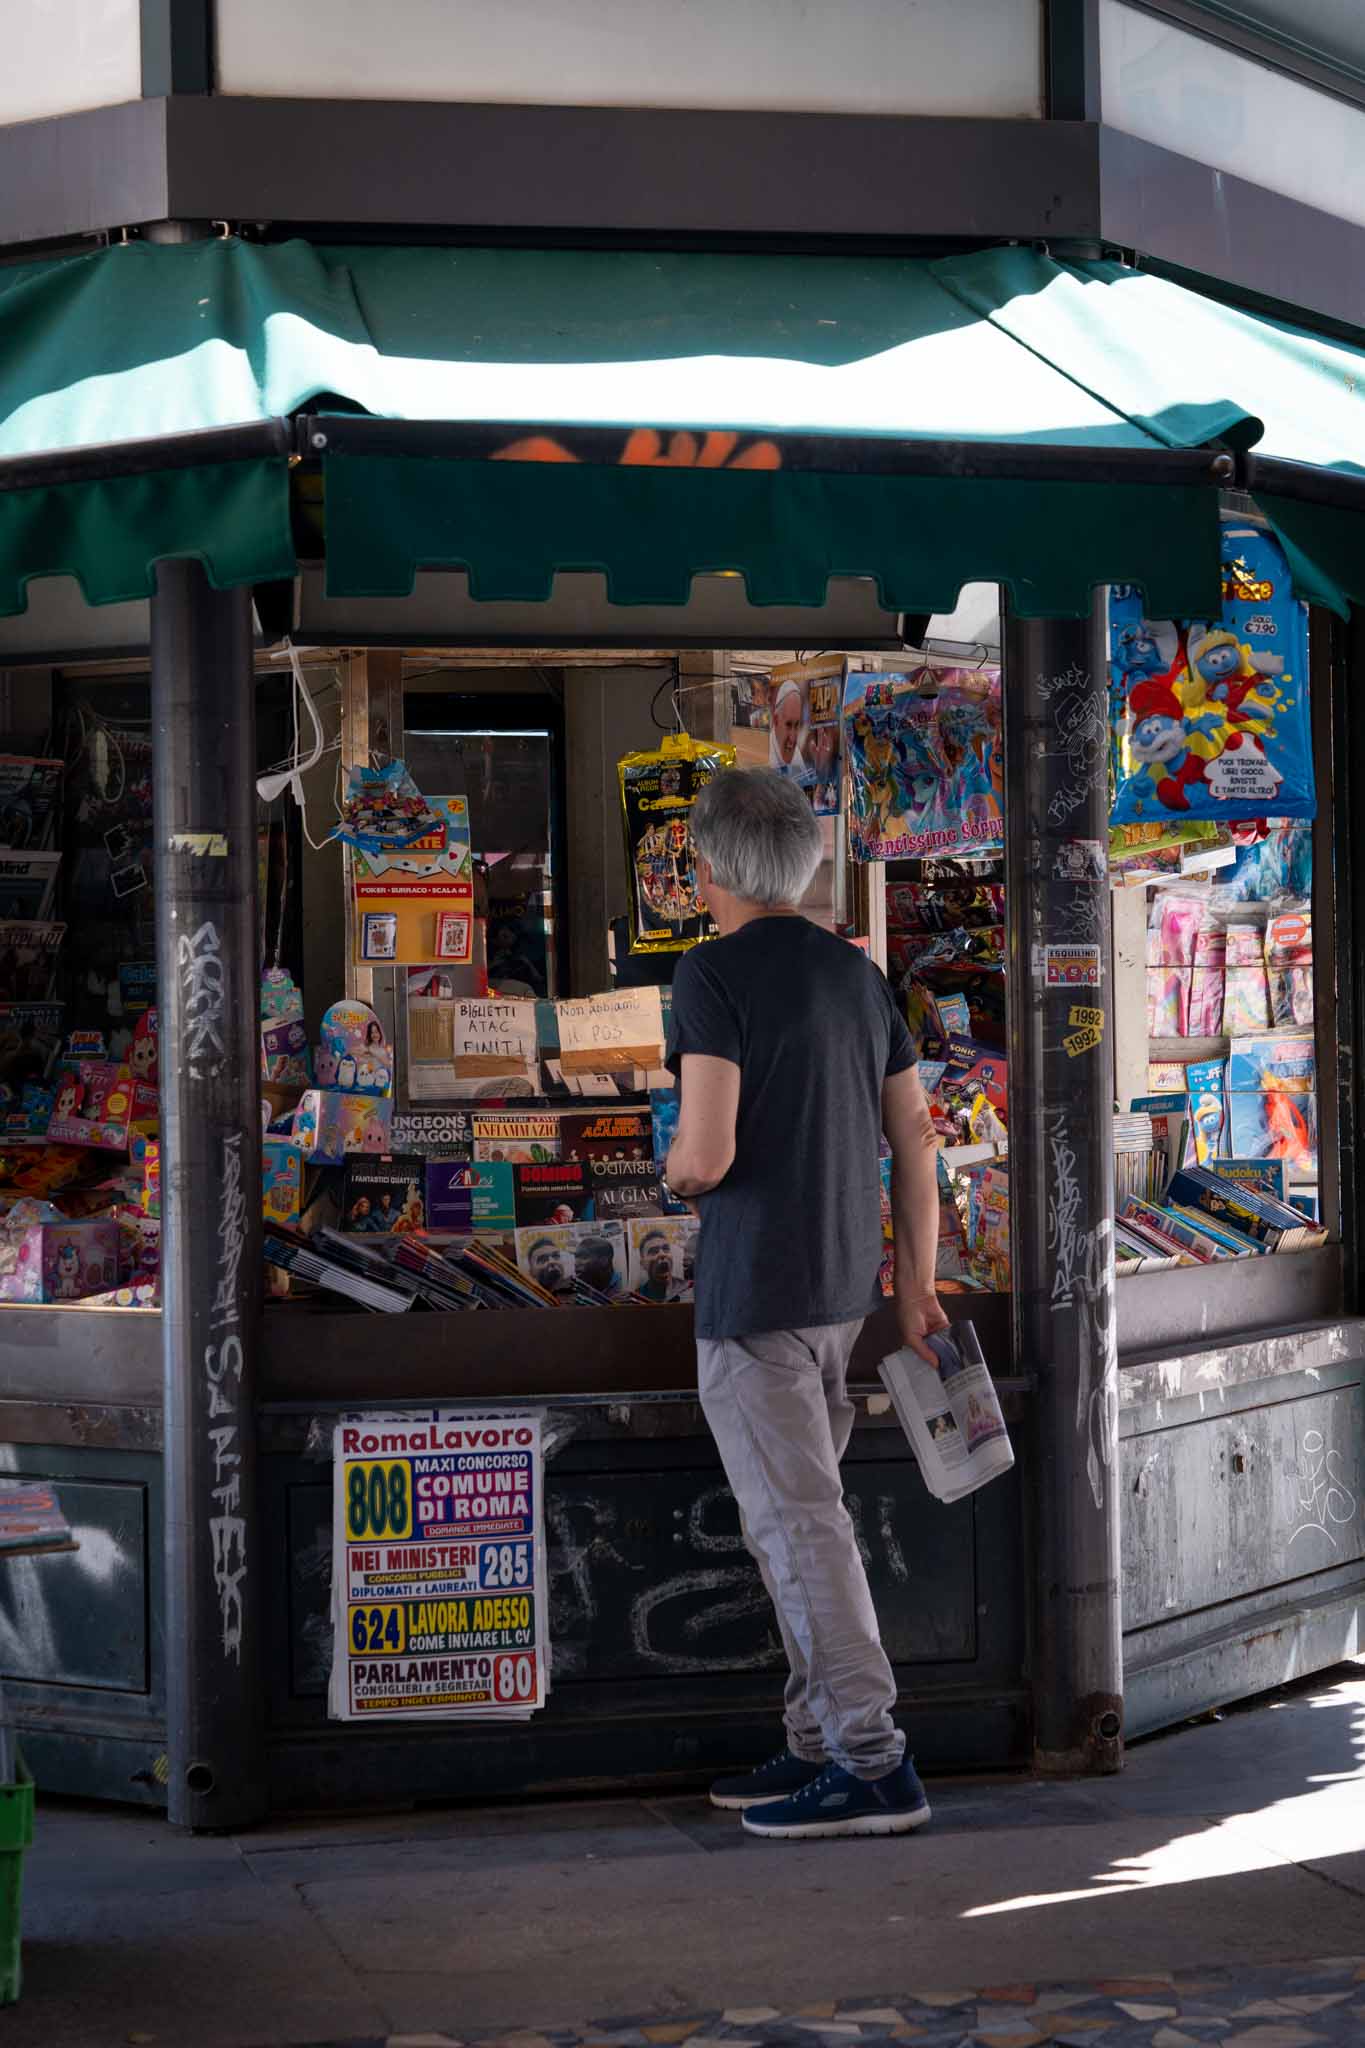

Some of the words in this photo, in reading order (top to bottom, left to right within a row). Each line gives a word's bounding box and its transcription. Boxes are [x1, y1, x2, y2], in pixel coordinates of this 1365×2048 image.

[460, 1004, 516, 1018] BIGLIETTI
[560, 1005, 584, 1017] Non
[589, 1000, 640, 1014] abbiamo
[1074, 1009, 1101, 1026] 1992
[468, 1020, 510, 1033] ATAC
[1070, 1029, 1097, 1052] 1992
[950, 1043, 977, 1057] SONIC
[355, 1176, 389, 1184] FANTASTICI
[391, 1176, 420, 1184] QUATTRO
[1217, 1167, 1261, 1178] Sudoku
[602, 1187, 658, 1204] AUGIAS
[343, 1425, 533, 1453] RomaLavoro
[414, 1458, 455, 1473] MAXI
[457, 1454, 528, 1471] CONCORSO
[416, 1470, 529, 1497] COMUNE
[349, 1464, 406, 1536] 808
[418, 1500, 445, 1521] DI
[454, 1494, 529, 1519] ROMA
[429, 1525, 471, 1535] DOMANDE
[351, 1551, 380, 1572] NEI
[387, 1545, 476, 1570] MINISTERI
[484, 1543, 529, 1586] 285
[368, 1574, 417, 1584] CONCORSI
[419, 1570, 463, 1580] PUBBLICI
[352, 1585, 412, 1597] DIPLOMATI
[425, 1582, 477, 1594] LAUREATI
[408, 1601, 469, 1635] LAVORA
[473, 1596, 529, 1631] ADESSO
[353, 1608, 400, 1650] 624
[409, 1635, 446, 1651] COME
[448, 1631, 498, 1648] INVIARE
[501, 1630, 512, 1645] IL
[515, 1629, 531, 1644] CV
[354, 1658, 491, 1685] PARLAMENTO
[500, 1655, 532, 1699] 80
[355, 1684, 422, 1697] CONSIGLIERI
[434, 1680, 492, 1692] SEGRETARI
[362, 1698, 399, 1708] TEMPO
[402, 1692, 486, 1706] INDETERMINATO
